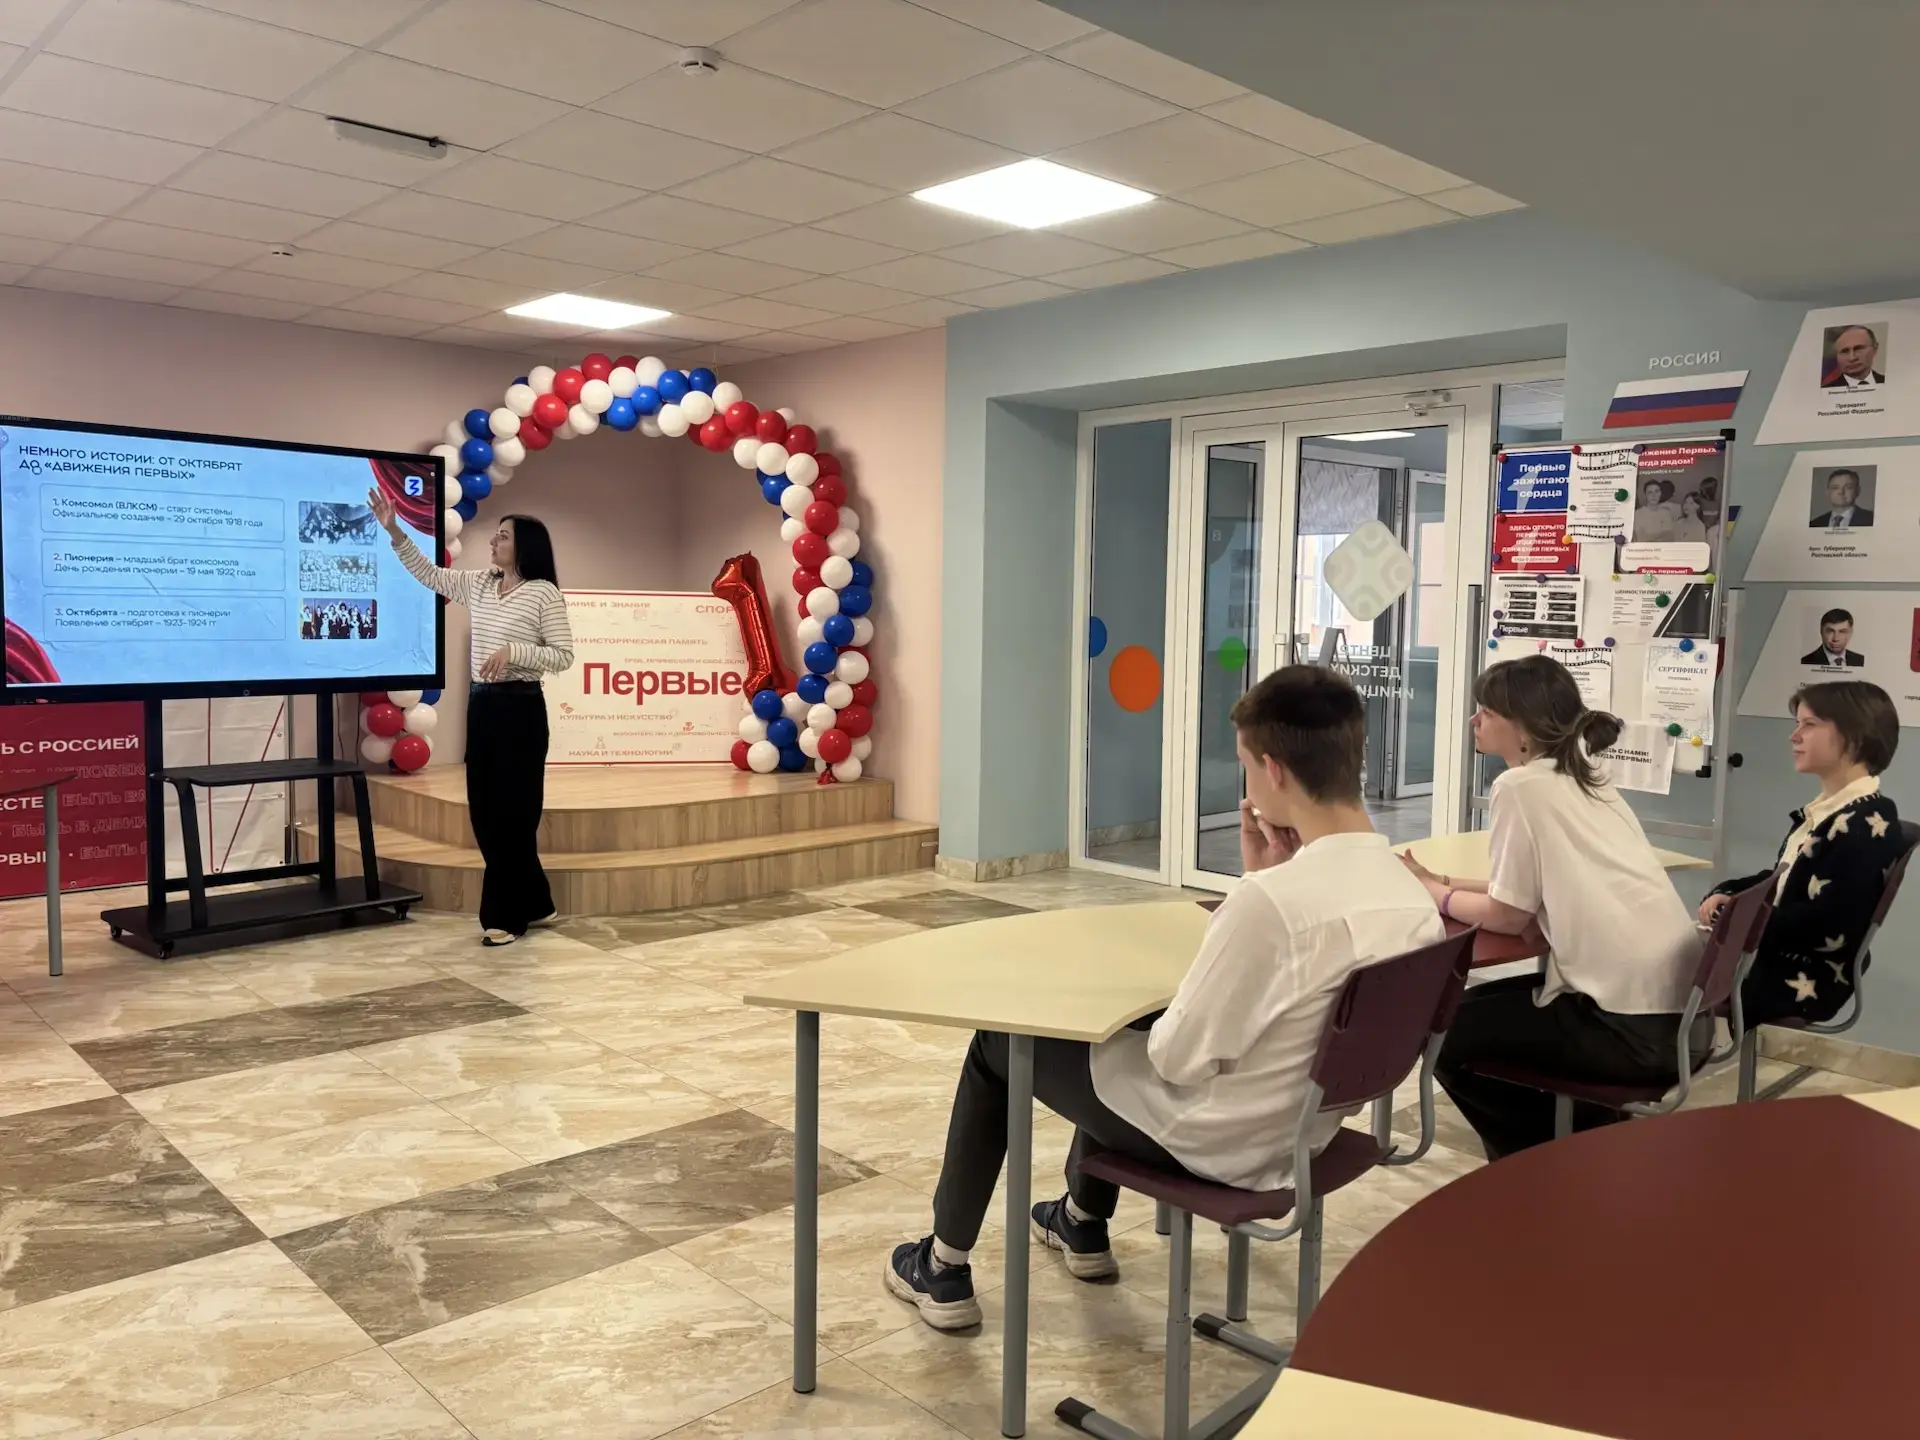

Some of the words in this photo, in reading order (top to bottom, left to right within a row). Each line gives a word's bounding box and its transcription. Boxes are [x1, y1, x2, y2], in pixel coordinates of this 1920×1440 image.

[1649, 350, 1721, 370] РОССИЯ
[1678, 447, 1717, 455] Первых
[19, 445, 86, 459] НЕМНОГО
[90, 451, 155, 464] ИСТОРИИ:
[158, 456, 175, 466] ОТ
[178, 458, 243, 472] ОКТЯБРЯТ
[1639, 458, 1660, 467] егда
[1660, 457, 1694, 466] рядом!
[44, 462, 131, 476] «ДВИЖЕНИЯ
[135, 467, 196, 480] ПЕРВЫХ»
[1520, 463, 1566, 473] Первые
[1520, 488, 1563, 499] сердца
[62, 498, 114, 509] Комсомол
[115, 501, 158, 511] (ВЛКСМ)
[166, 506, 192, 514] старт
[193, 507, 233, 516] системы
[52, 508, 119, 520] Официальное
[121, 513, 165, 523] создание
[174, 514, 186, 523] 29
[187, 516, 224, 526] октября
[225, 517, 243, 526] 1918
[244, 520, 264, 528] года
[64, 554, 114, 563] Пионерия
[123, 556, 166, 565] младший
[167, 556, 188, 566] брат
[54, 564, 80, 574] День
[81, 565, 131, 575] рождения
[132, 566, 178, 576] пионерии
[187, 567, 196, 575] 19
[197, 568, 214, 576] мая
[216, 567, 235, 576] 1922
[236, 569, 256, 577] года
[65, 608, 118, 618] Октябрята
[127, 609, 179, 618] подготовка
[188, 609, 231, 618] пионерии
[695, 605, 735, 614] СПОР
[55, 618, 109, 626] Появление
[111, 617, 153, 628] октябрят
[1500, 625, 1528, 634] Первые
[590, 637, 667, 645] ИСТОРИЧЕСКАЯ
[668, 638, 708, 646] ПАМЯТЬ
[1658, 665, 1709, 675] СЕРТИФИКАТ
[583, 662, 742, 706] Первые
[19, 741, 34, 754] С
[39, 734, 140, 753] РОССИЕЙ
[610, 749, 673, 757] ТЕХНОЛОГИИ
[1615, 754, 1652, 764] ПЕРВЫМ!
[1624, 749, 1650, 757] НАМИ!
[77, 762, 146, 779] ЛОВЕК
[0, 795, 45, 811] СТЕ
[62, 791, 120, 807] БЫТЬ
[12, 820, 73, 838] БЫЬ
[80, 842, 138, 860] БЫТЬ
